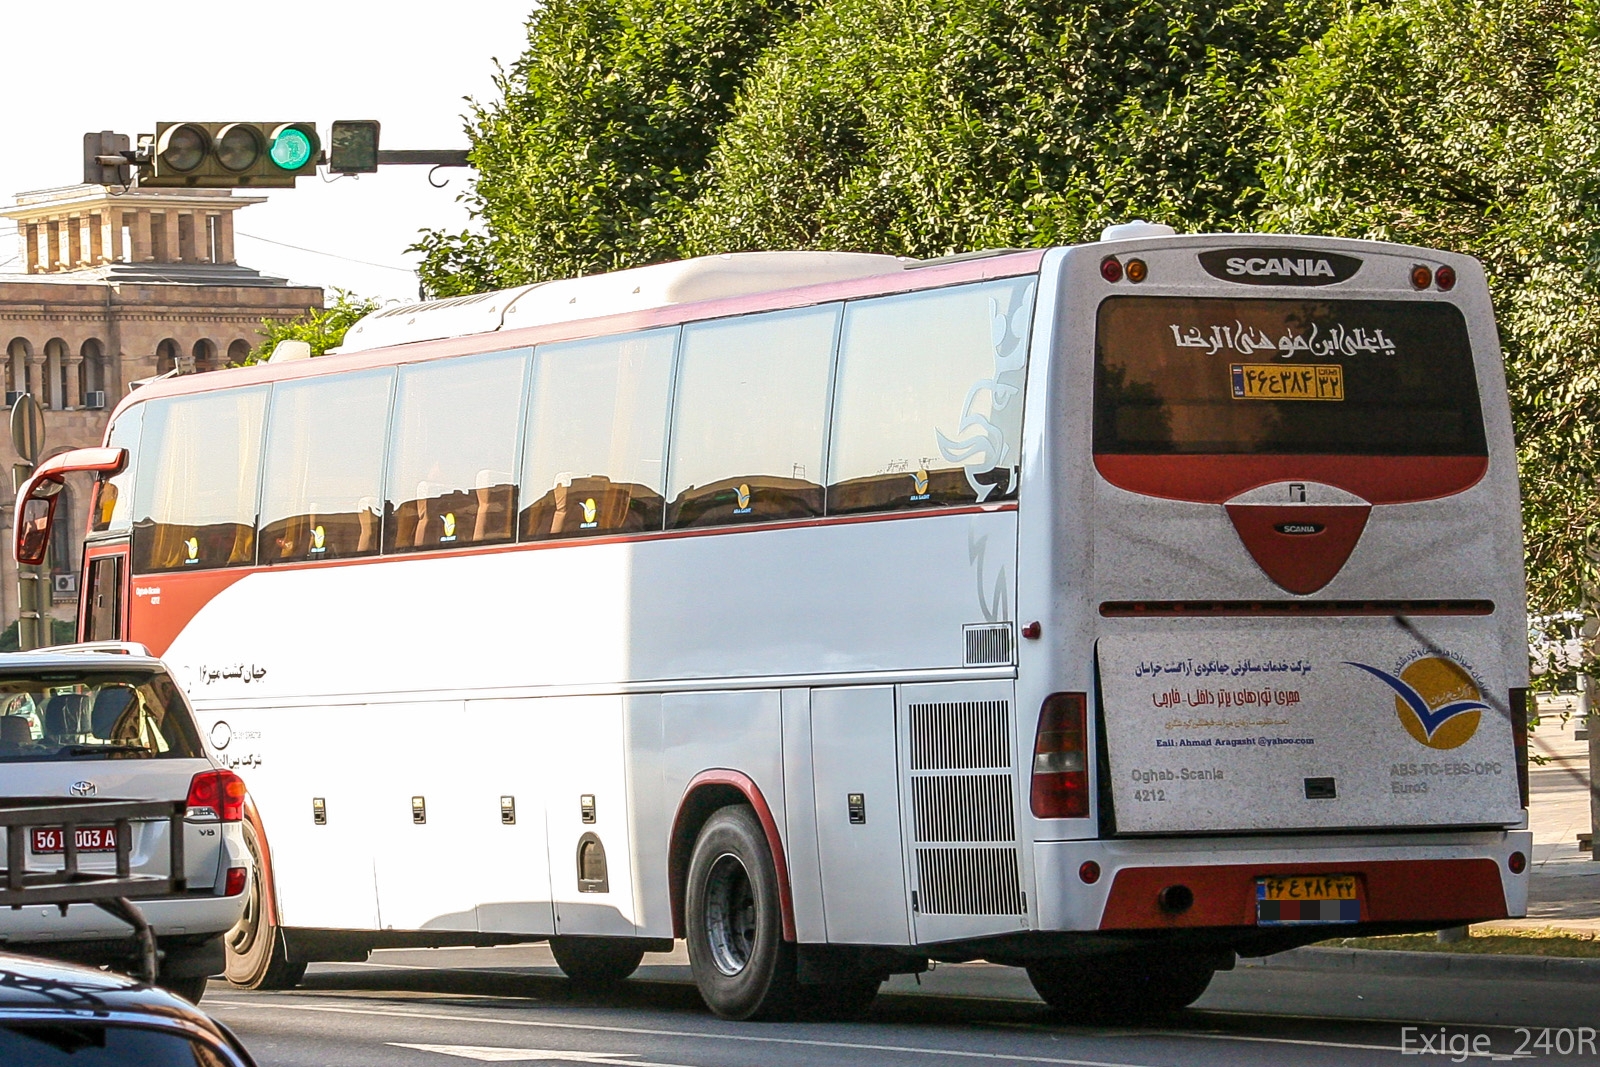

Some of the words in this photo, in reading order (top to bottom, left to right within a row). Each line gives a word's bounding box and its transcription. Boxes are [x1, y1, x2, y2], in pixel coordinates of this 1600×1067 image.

[1226, 257, 1335, 277] SCANIA
[1169, 324, 1233, 355] الرضا
[1309, 322, 1339, 356] ابن
[1284, 525, 1315, 533] SCANIA
[1290, 659, 1311, 675] شرکت
[1179, 738, 1212, 747] Ahmad
[1215, 737, 1256, 748] Aragasht
[1258, 736, 1315, 748] @yahoo.com
[1134, 789, 1166, 801] 4212
[37, 831, 55, 848] 56
[75, 830, 101, 847] 003
